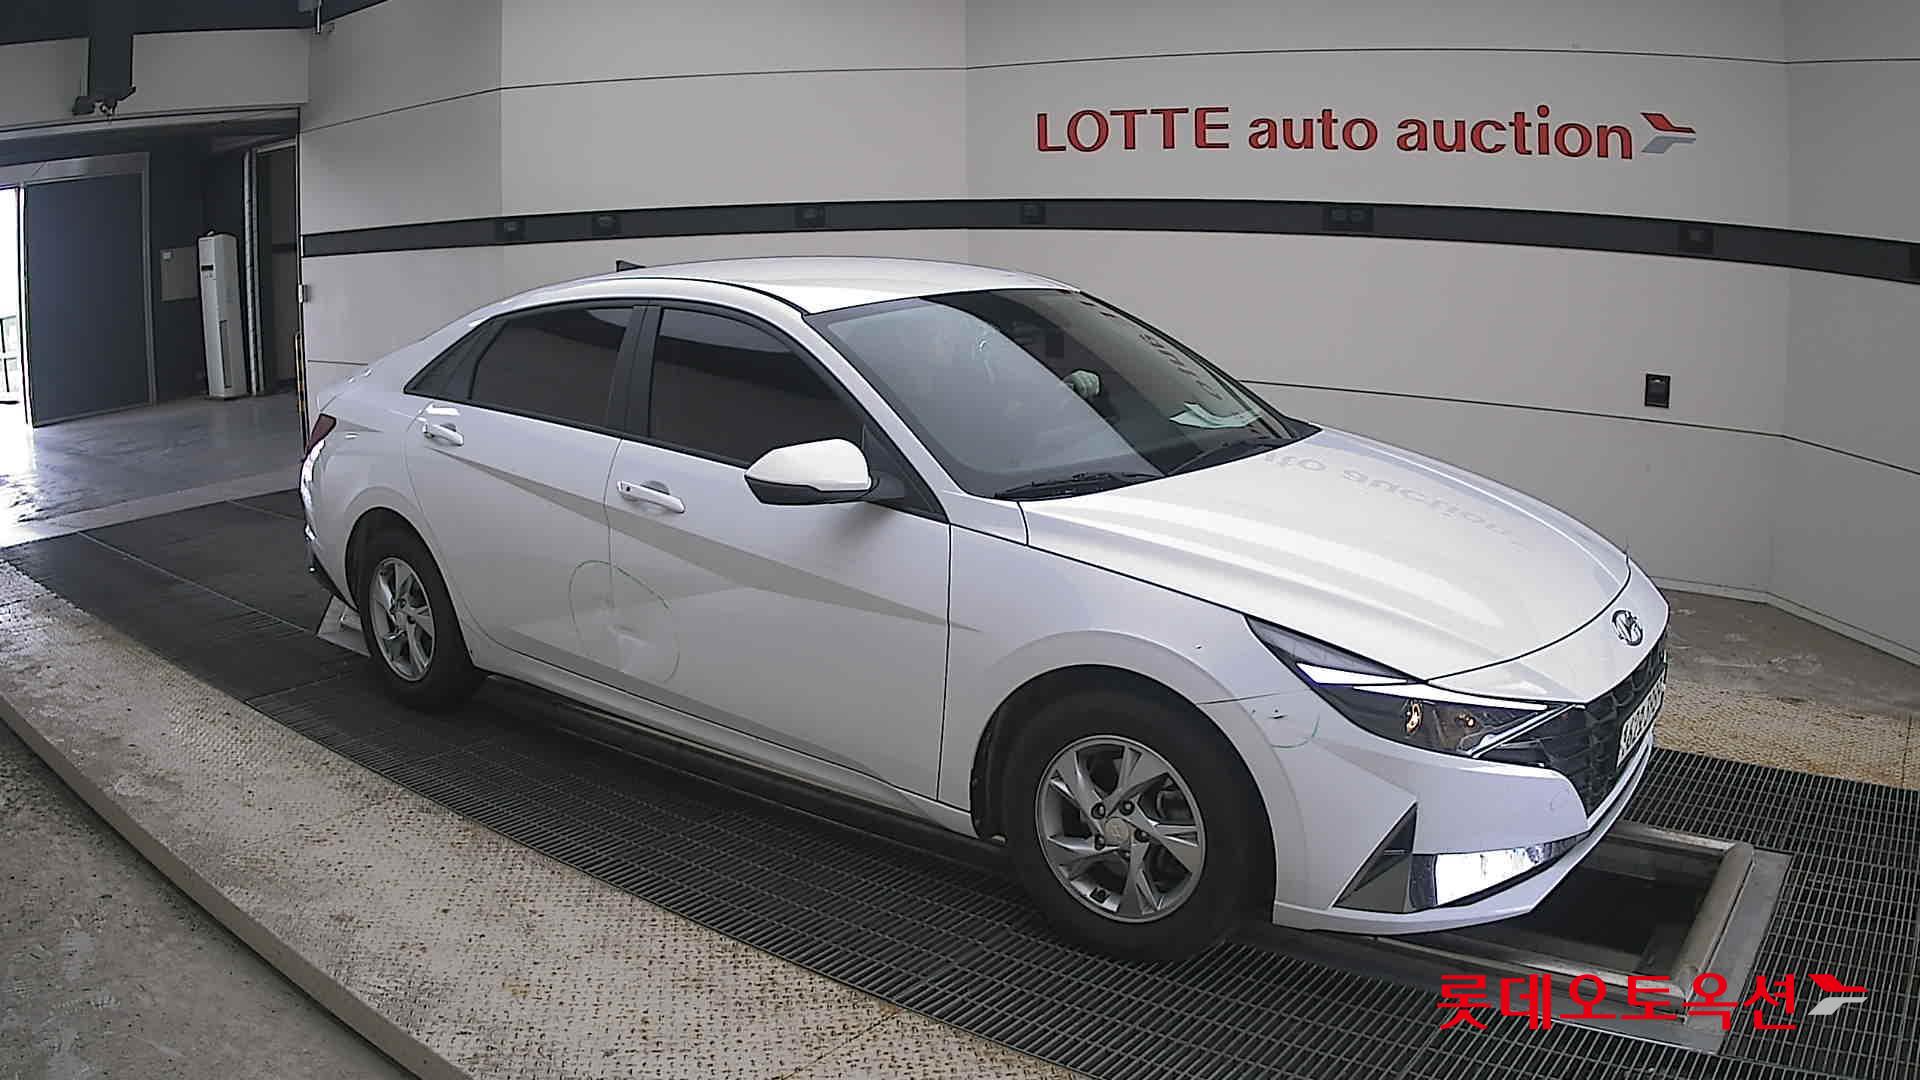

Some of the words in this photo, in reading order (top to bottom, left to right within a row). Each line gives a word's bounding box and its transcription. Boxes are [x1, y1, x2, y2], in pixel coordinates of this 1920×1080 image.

[1036, 106, 1230, 152] LOTTE
[1248, 108, 1378, 151] auto
[1396, 105, 1633, 159] auction
